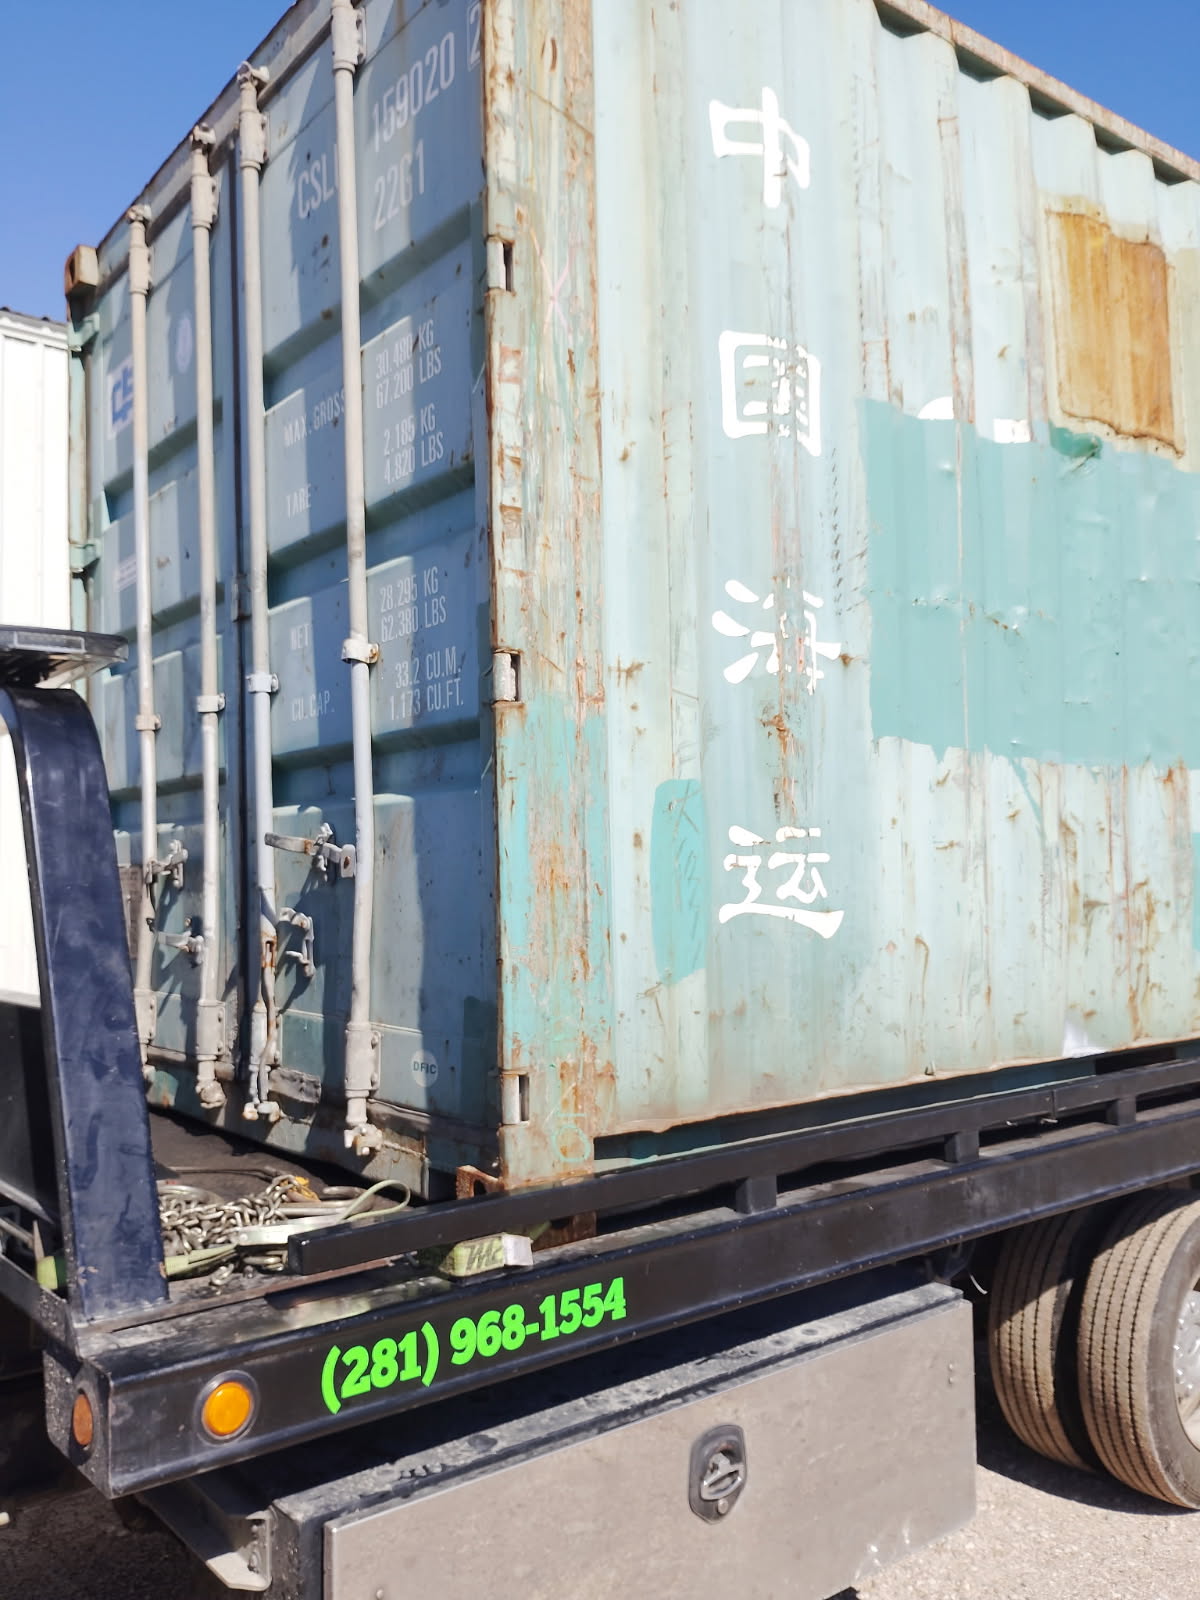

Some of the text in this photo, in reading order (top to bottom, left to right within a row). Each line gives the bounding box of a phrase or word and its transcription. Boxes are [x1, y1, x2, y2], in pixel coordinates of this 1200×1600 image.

[372, 32, 455, 152] 159020
[418, 319, 434, 352] KG
[419, 346, 442, 384] LBS
[286, 484, 311, 518] TARE
[421, 403, 436, 436] KG
[421, 432, 444, 467] LBS
[290, 566, 439, 650] NET 28.295 KG
[425, 595, 447, 629] LBS
[395, 656, 420, 688] 33.2
[390, 688, 421, 721] 1.173
[413, 1061, 437, 1075] DFIC
[321, 1276, 627, 1415] (281) 968-1554
